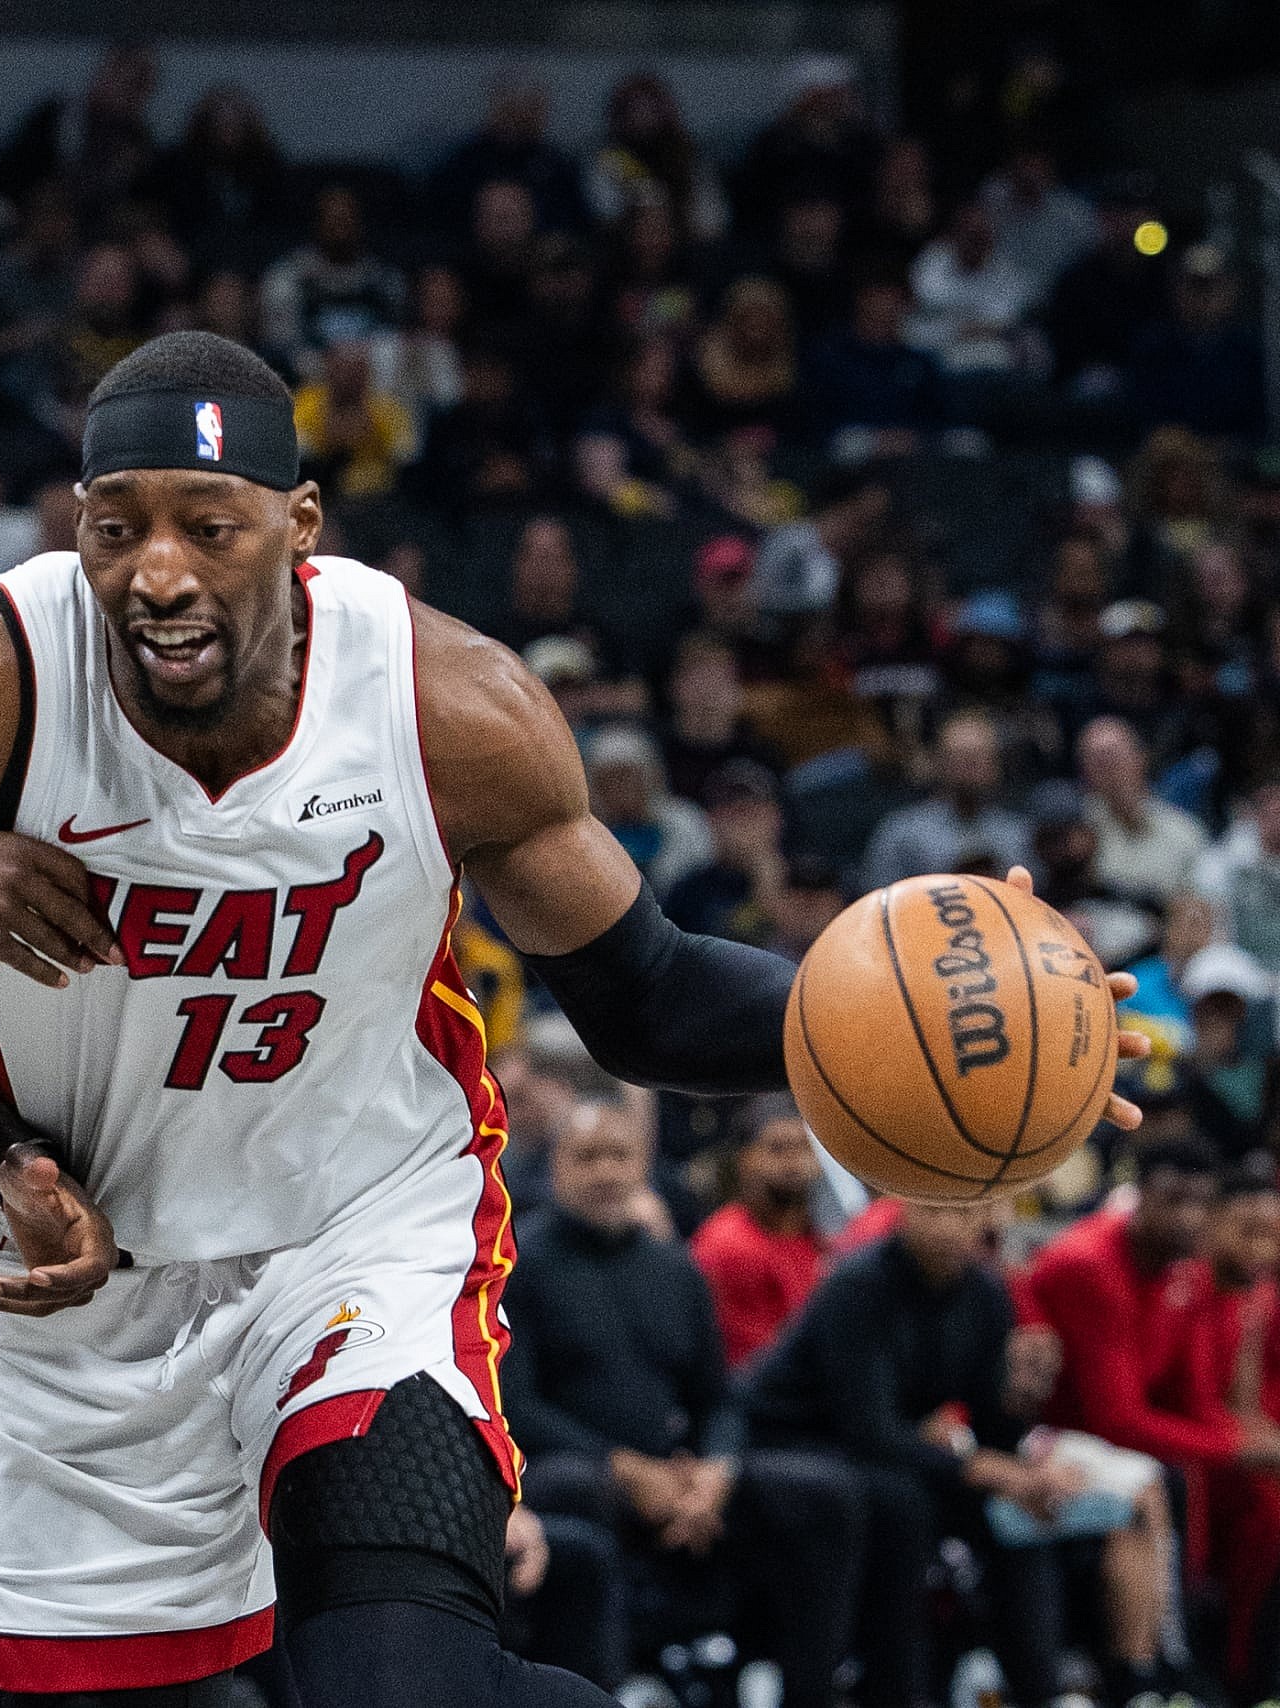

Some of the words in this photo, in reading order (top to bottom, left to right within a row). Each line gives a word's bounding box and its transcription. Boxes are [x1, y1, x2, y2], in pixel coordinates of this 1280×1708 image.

[316, 788, 384, 816] Carnival
[86, 829, 385, 981] EAT
[163, 989, 327, 1091] 13
[927, 883, 1012, 1078] Wilson
